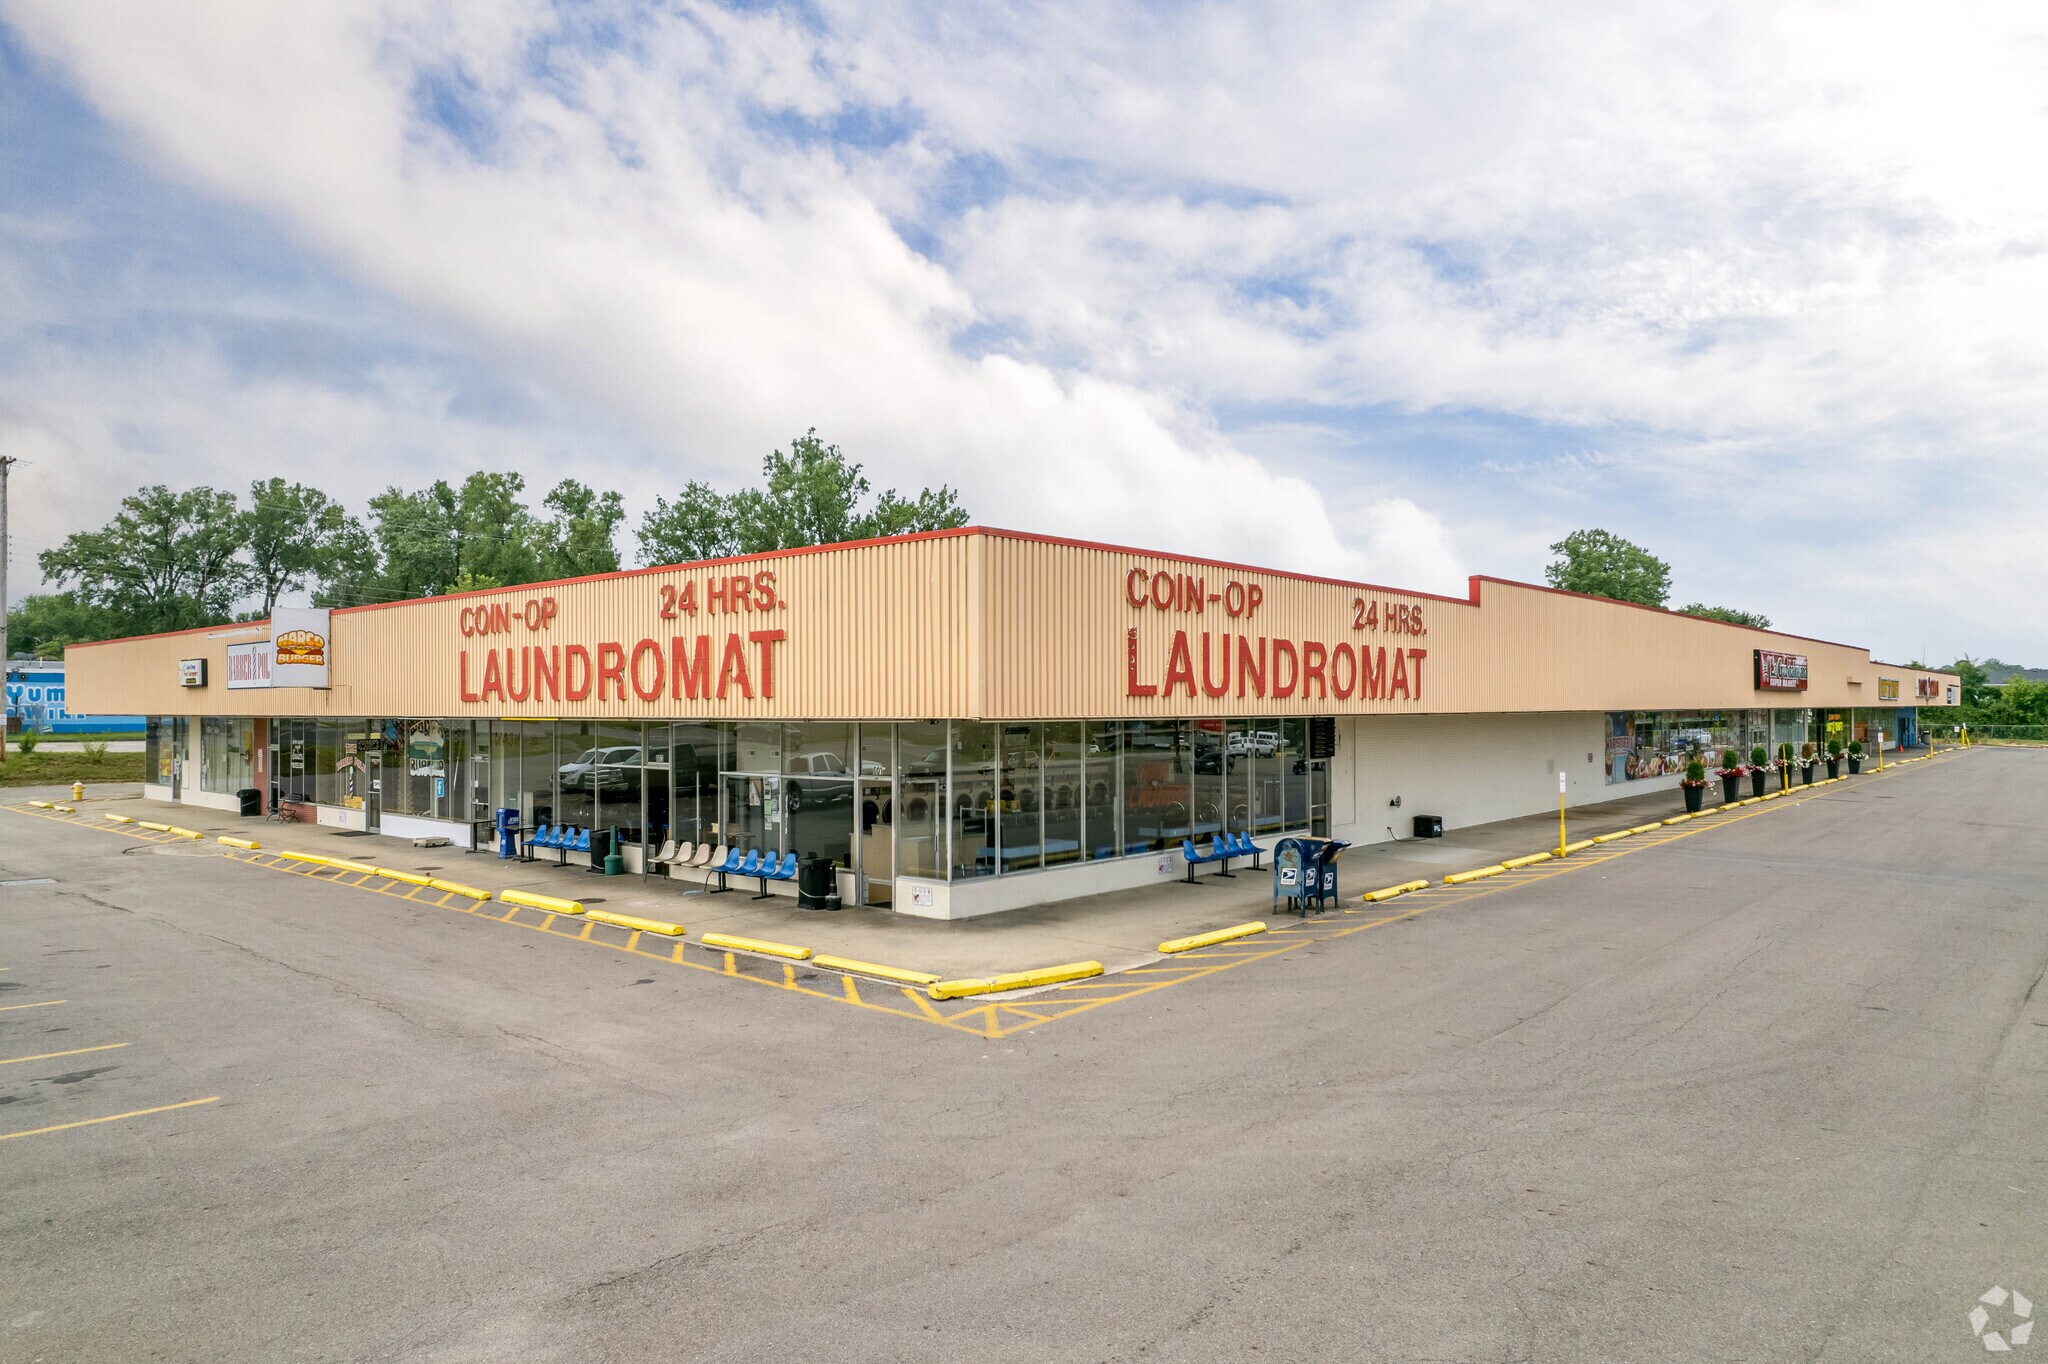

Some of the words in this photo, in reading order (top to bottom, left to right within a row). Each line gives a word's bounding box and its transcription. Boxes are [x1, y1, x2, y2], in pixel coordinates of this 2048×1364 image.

[660, 580, 698, 619] 24
[708, 571, 786, 615] HRS.
[1126, 567, 1263, 619] COIN-OP
[460, 597, 558, 637] COIN-OP
[1352, 597, 1379, 631] 24
[1383, 602, 1427, 636] HRS.
[228, 653, 252, 681] BARBER
[277, 654, 325, 665] BURGER
[460, 629, 787, 702] LAUNDROMAT
[1126, 627, 1427, 701] LAUNDROMAT
